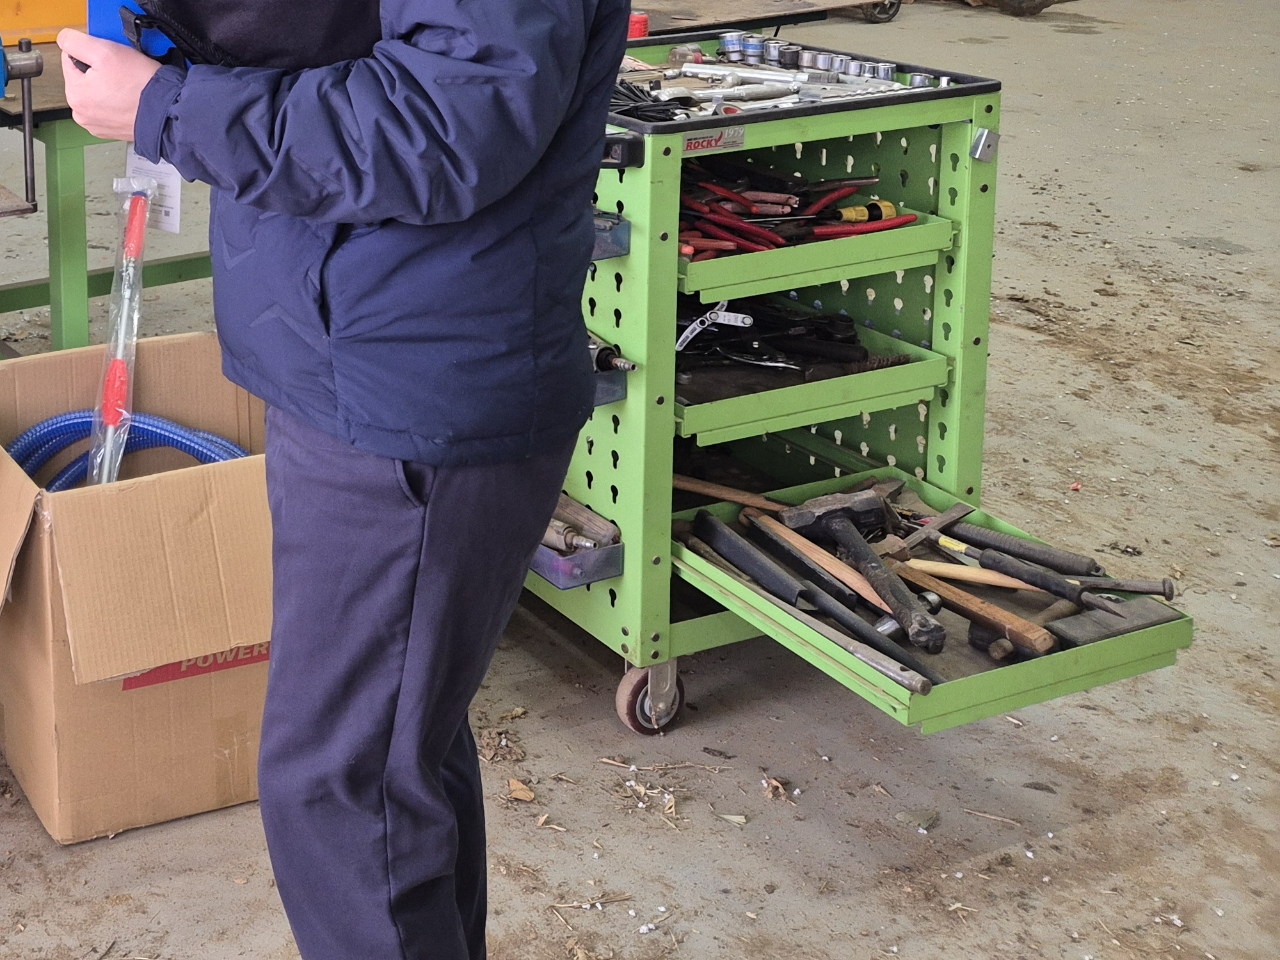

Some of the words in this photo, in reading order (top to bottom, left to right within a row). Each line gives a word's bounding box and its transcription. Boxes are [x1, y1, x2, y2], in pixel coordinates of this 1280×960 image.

[724, 127, 745, 138] 1979
[686, 134, 721, 151] ROCKY
[180, 641, 270, 672] POWER
